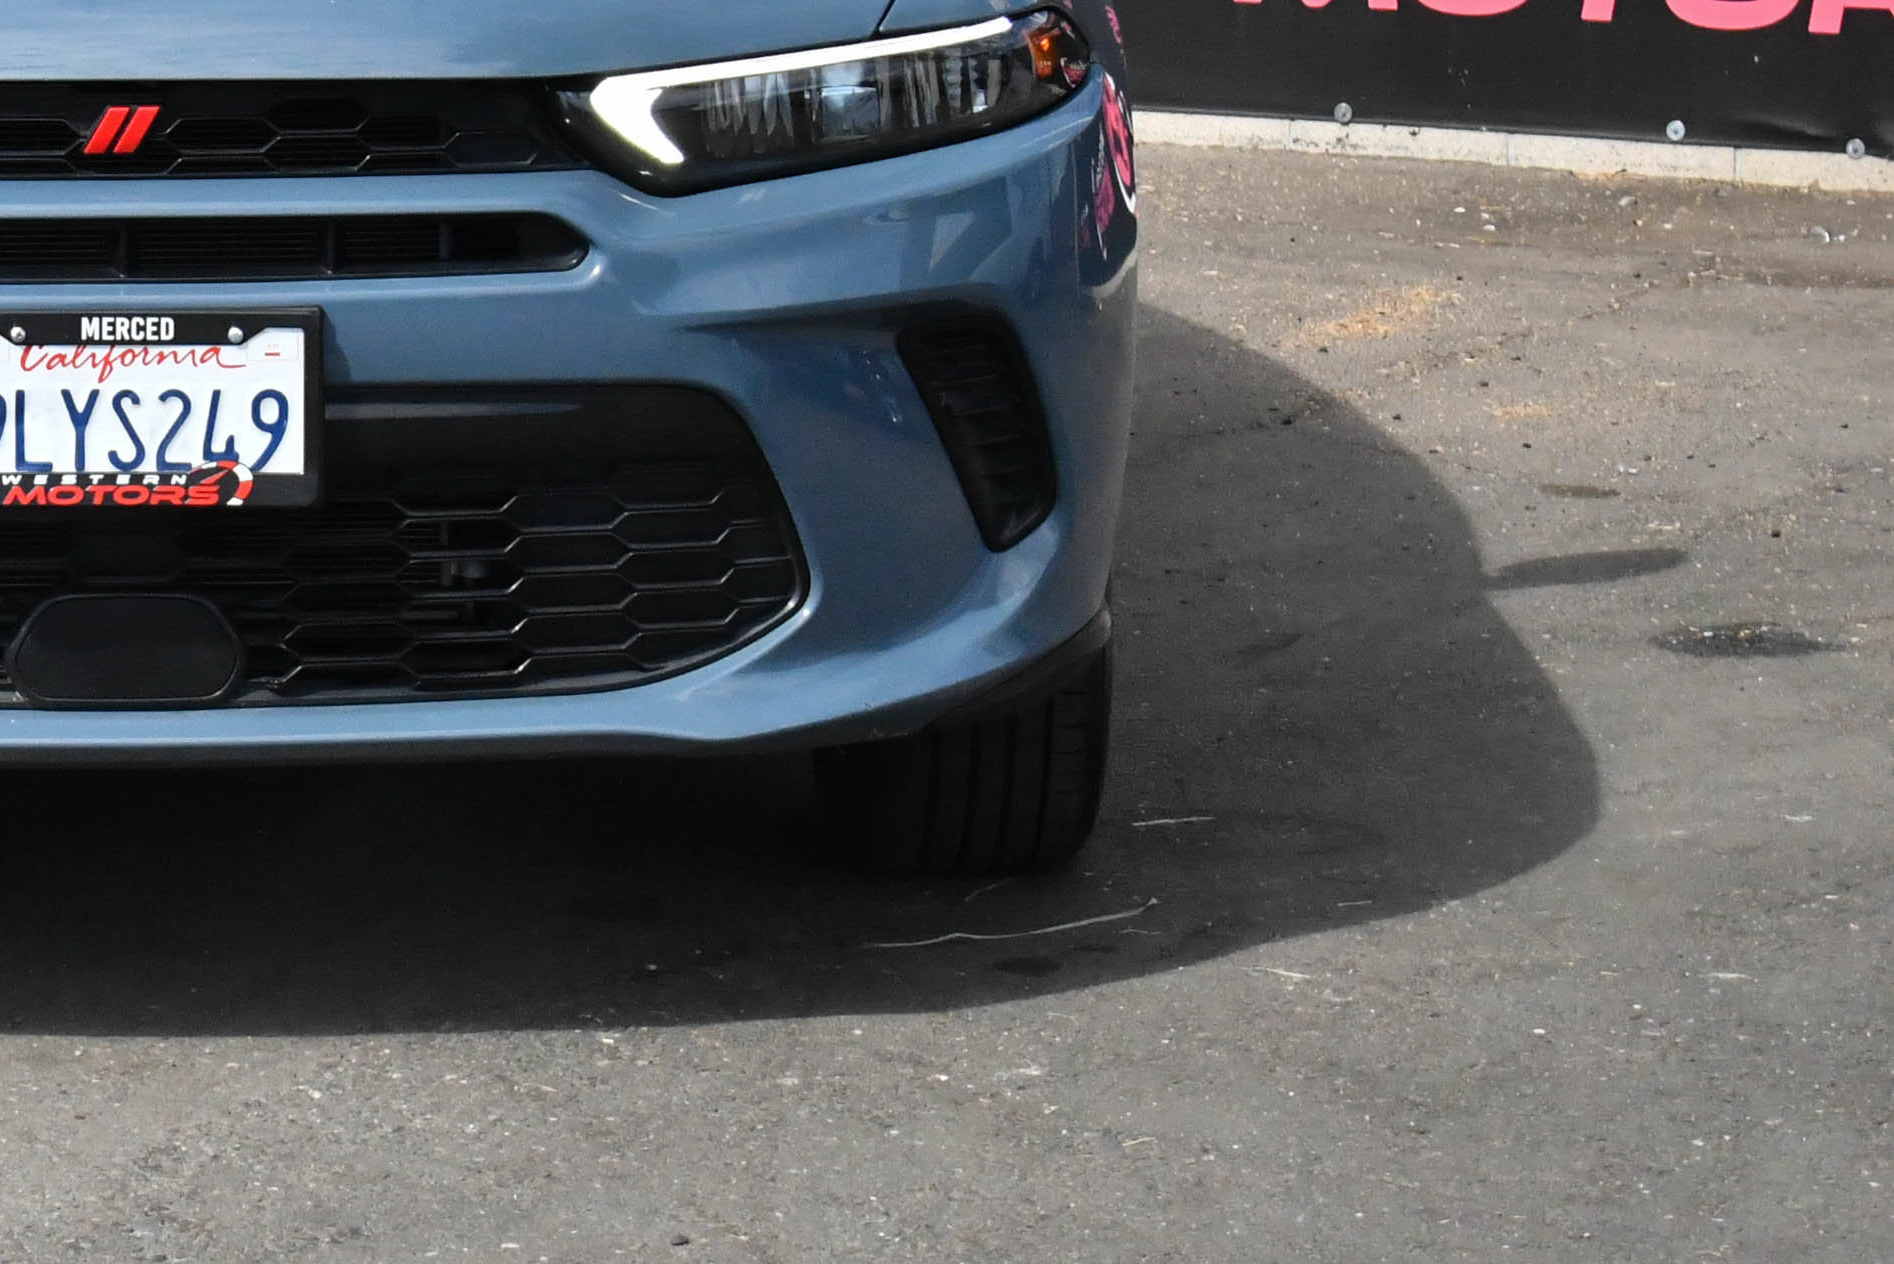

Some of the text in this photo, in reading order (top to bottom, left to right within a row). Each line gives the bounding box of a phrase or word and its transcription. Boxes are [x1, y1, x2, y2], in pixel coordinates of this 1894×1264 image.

[80, 316, 175, 341] MERCED
[19, 344, 246, 384] California
[1, 473, 188, 486] WESTERN
[2, 484, 220, 506] MOTORS
